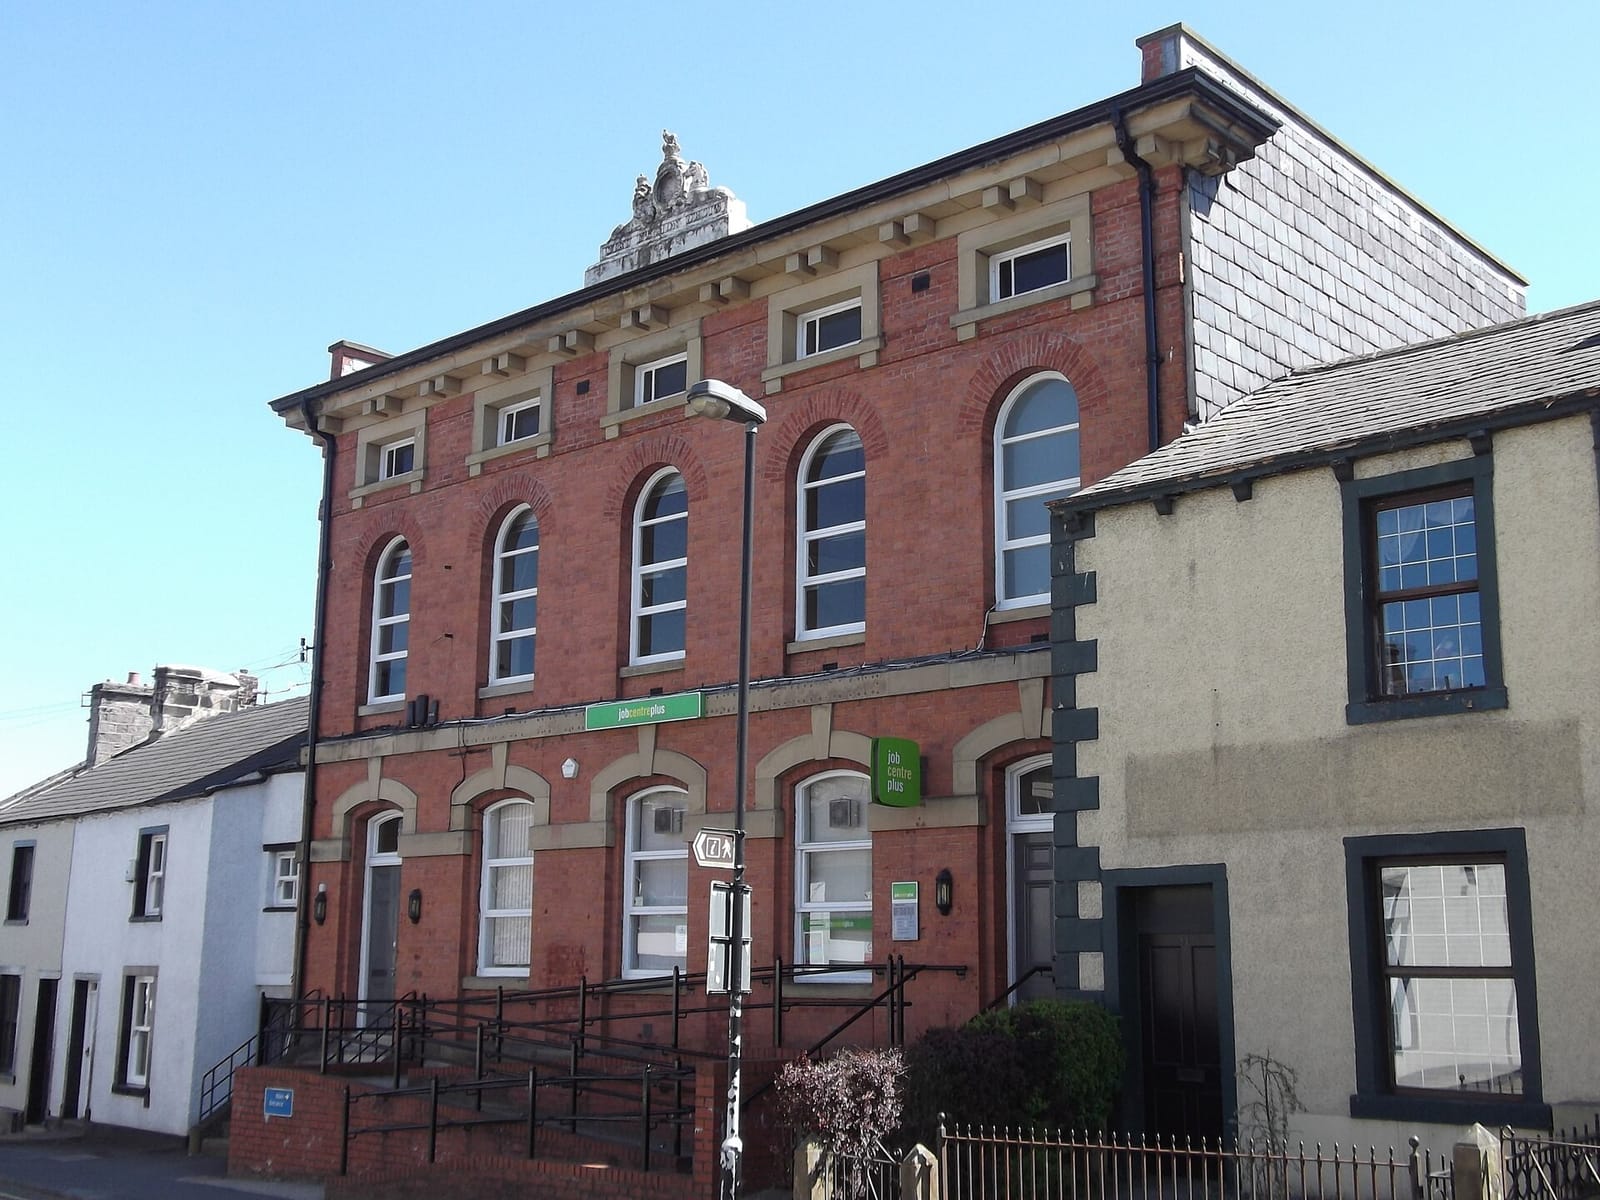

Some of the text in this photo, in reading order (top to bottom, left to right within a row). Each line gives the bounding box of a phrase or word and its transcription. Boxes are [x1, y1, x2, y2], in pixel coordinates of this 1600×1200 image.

[887, 749, 901, 765] job
[887, 766, 912, 780] centre
[887, 778, 904, 792] plus
